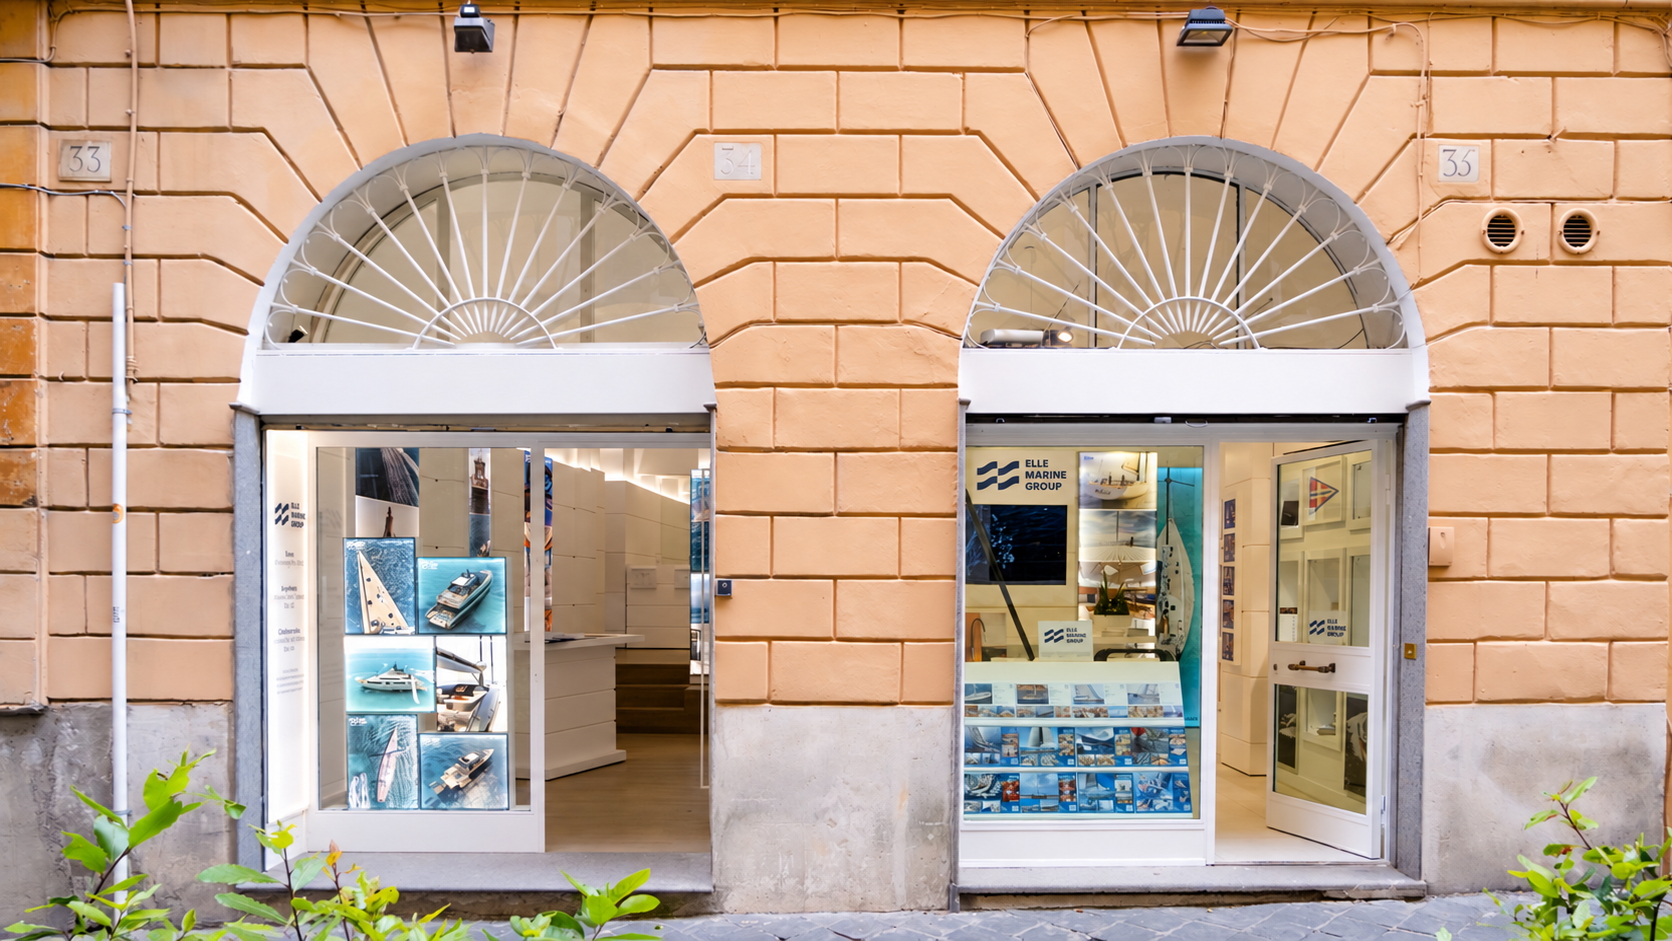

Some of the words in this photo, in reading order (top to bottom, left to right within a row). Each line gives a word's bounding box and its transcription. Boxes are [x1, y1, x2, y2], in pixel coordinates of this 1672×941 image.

[69, 145, 101, 173] 33
[720, 147, 756, 175] 34
[1442, 148, 1476, 178] 35
[1025, 459, 1049, 468] ELLE
[1025, 470, 1067, 479] MARINE
[1025, 482, 1062, 491] GROUP
